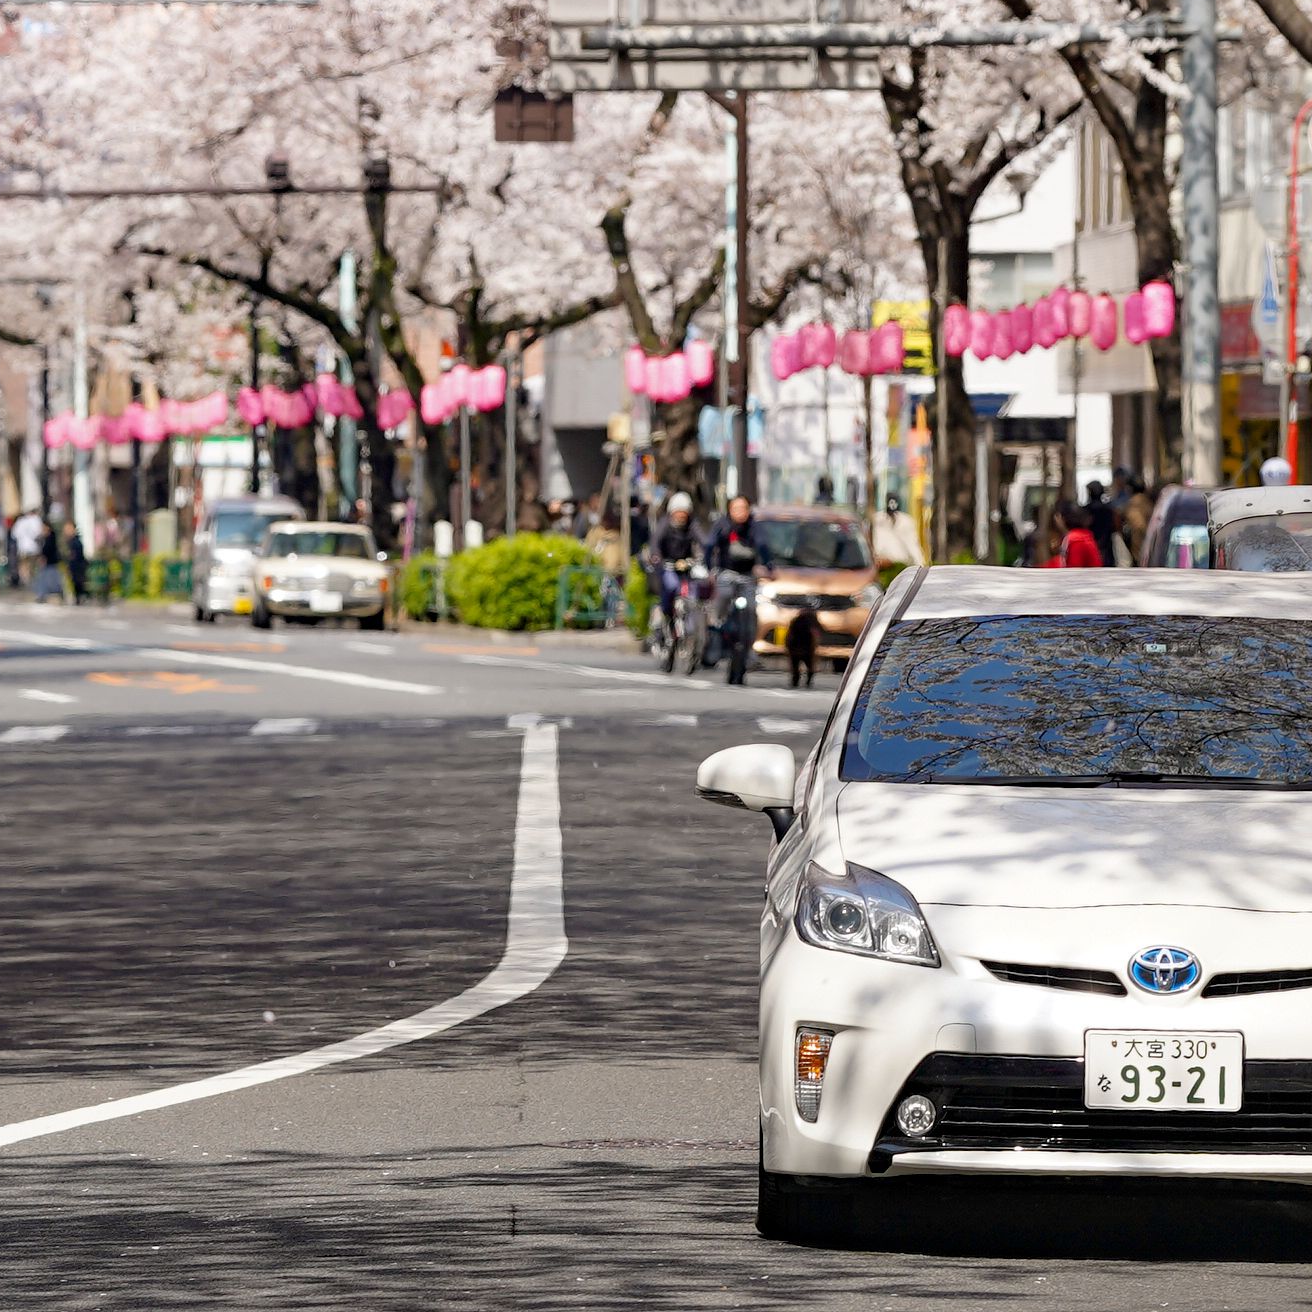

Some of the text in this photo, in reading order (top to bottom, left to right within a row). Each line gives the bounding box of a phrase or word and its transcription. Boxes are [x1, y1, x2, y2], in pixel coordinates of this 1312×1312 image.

[1124, 1039, 1208, 1059] 大宮 330
[1097, 1064, 1226, 1105] な 93-21
